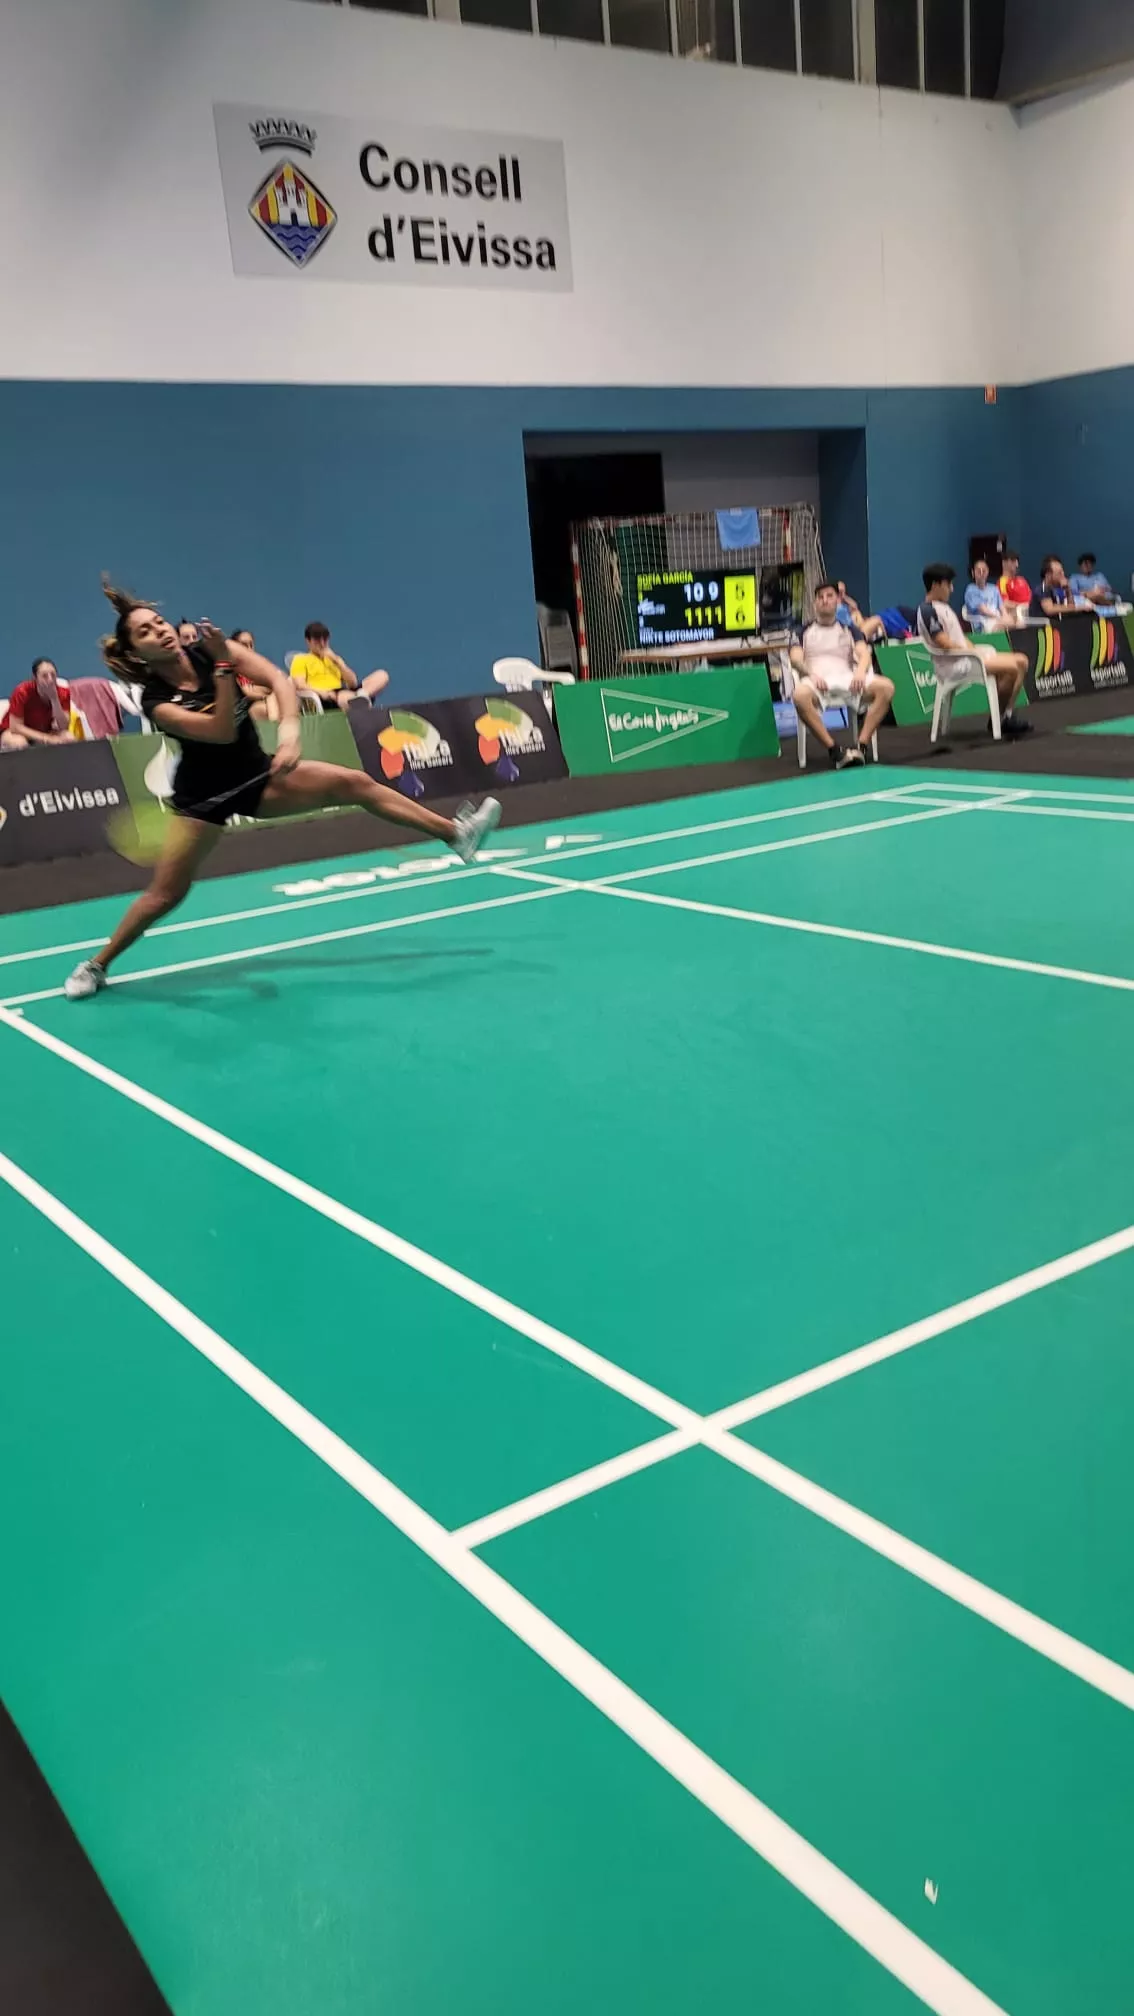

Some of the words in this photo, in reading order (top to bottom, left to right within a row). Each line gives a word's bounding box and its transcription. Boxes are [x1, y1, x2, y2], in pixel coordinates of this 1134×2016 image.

[359, 142, 522, 203] Consell
[368, 213, 557, 271] d'Eivissa
[684, 582, 704, 603] 10
[708, 581, 719, 601] 9
[736, 606, 746, 626] 6
[19, 787, 120, 816] d'Eivissa
